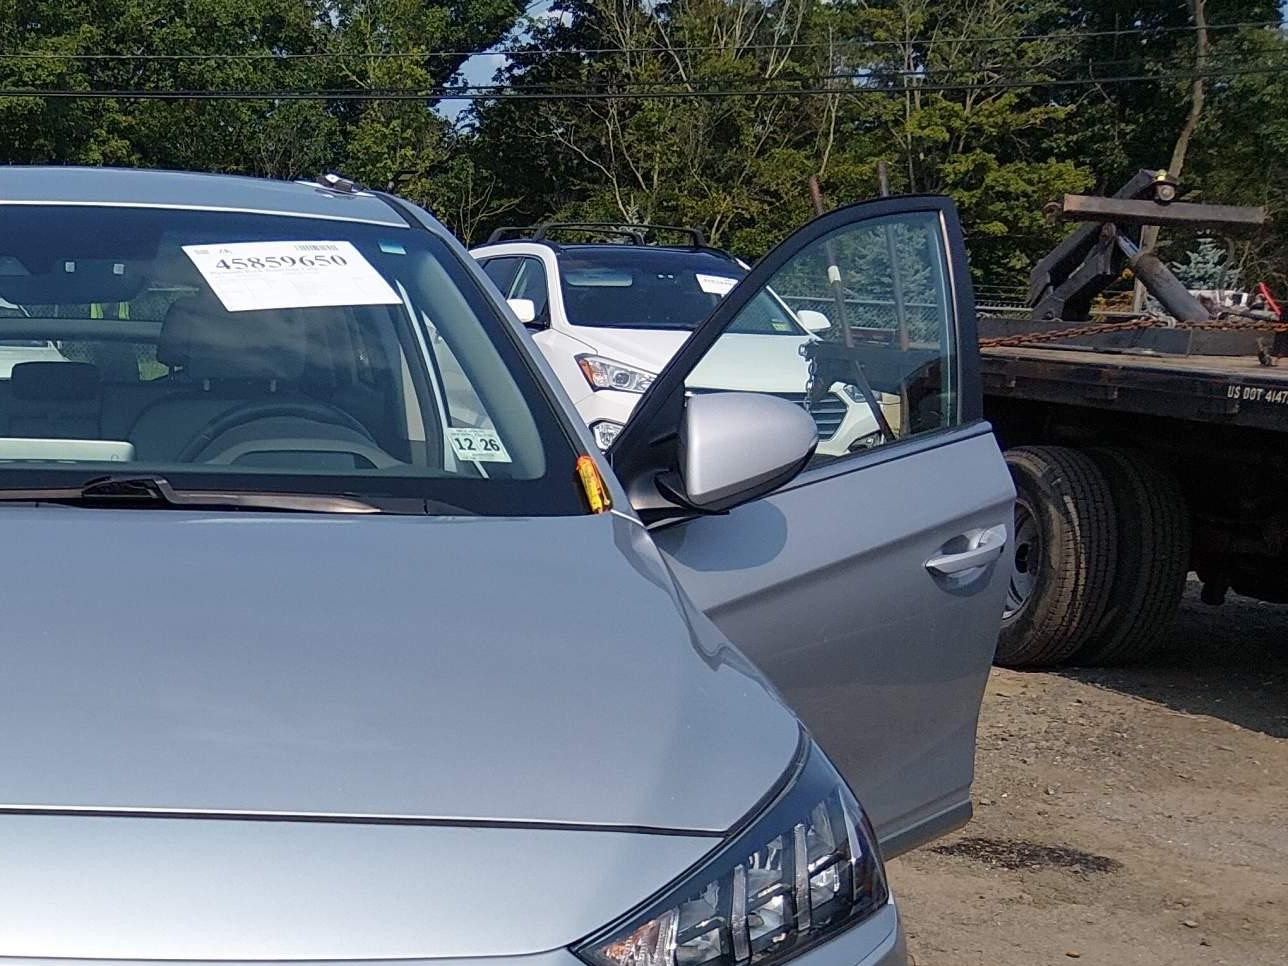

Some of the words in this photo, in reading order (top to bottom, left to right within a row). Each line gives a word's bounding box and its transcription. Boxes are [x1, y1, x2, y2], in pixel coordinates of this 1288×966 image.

[215, 254, 348, 270] 45859650
[1227, 385, 1241, 399] US
[1243, 387, 1264, 401] DOT
[1265, 390, 1288, 405] 4147
[454, 438, 476, 451] 12
[480, 438, 500, 452] 26
